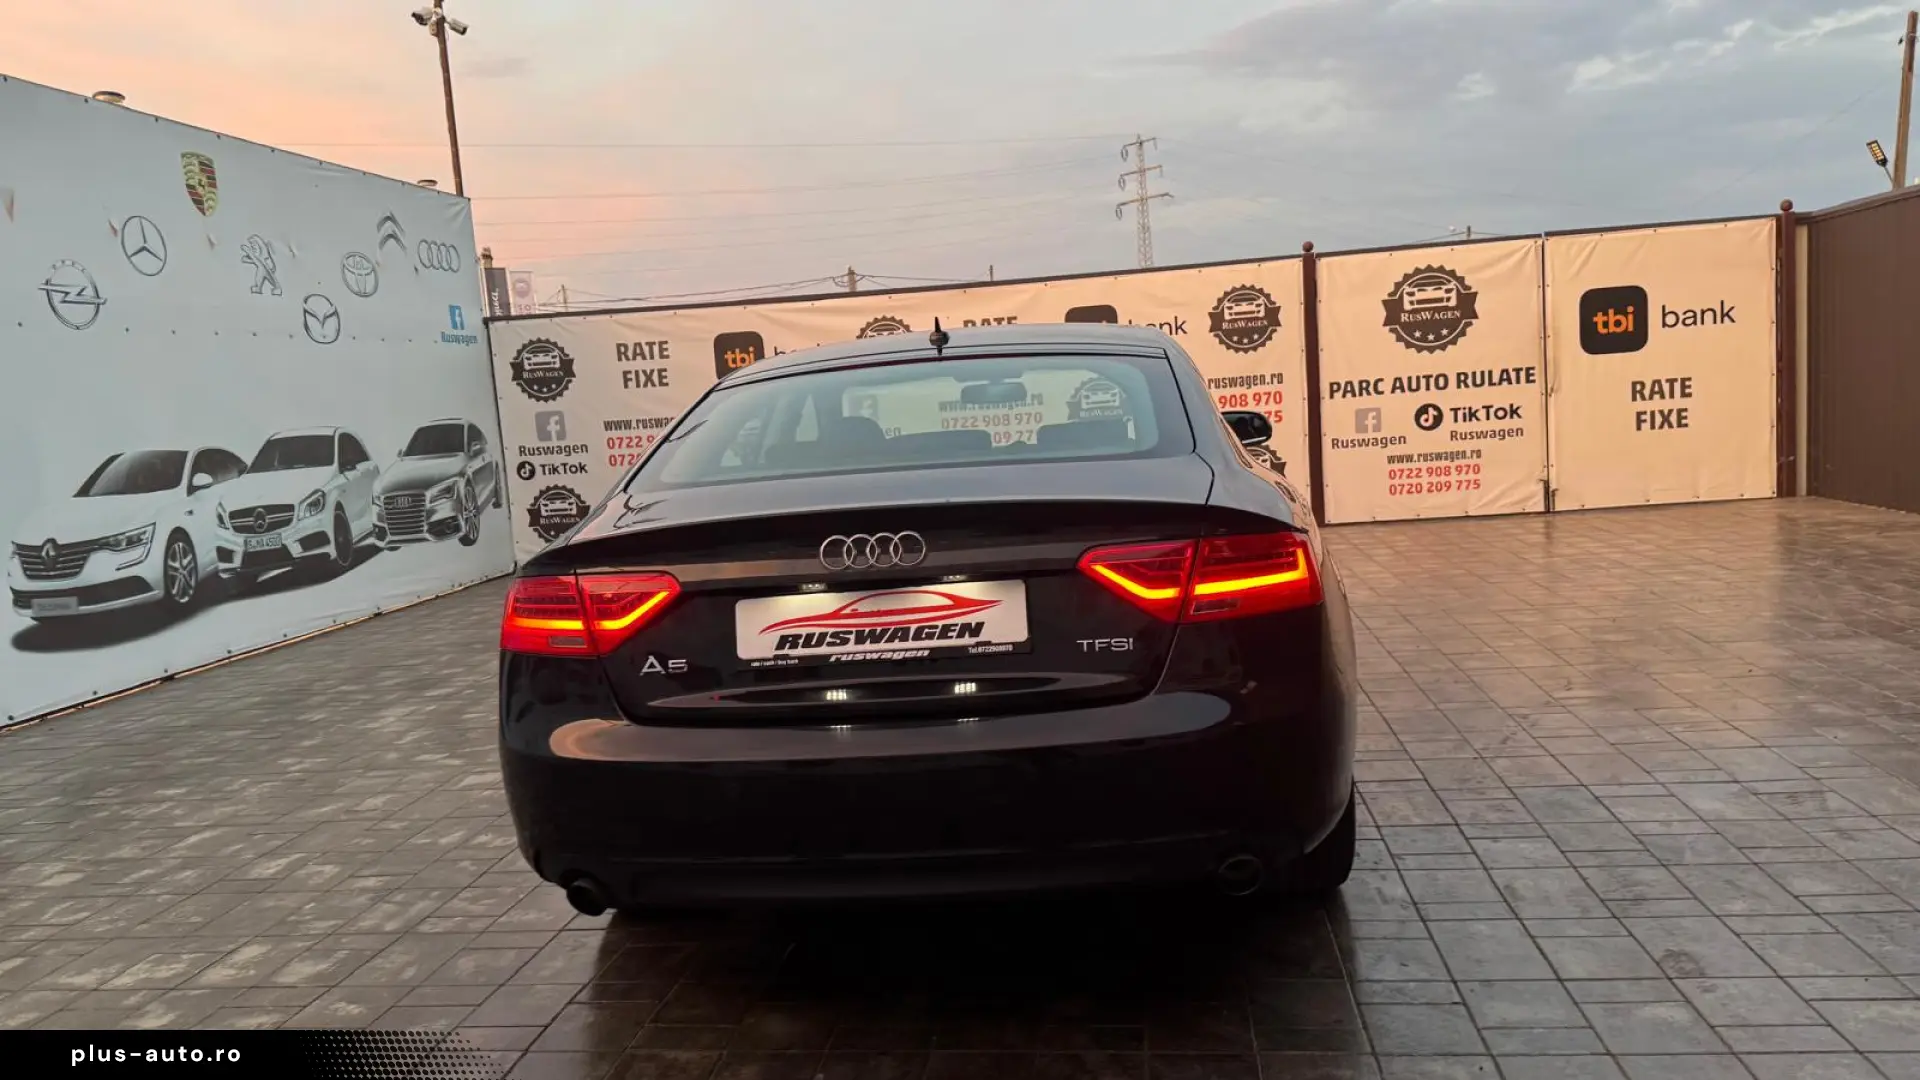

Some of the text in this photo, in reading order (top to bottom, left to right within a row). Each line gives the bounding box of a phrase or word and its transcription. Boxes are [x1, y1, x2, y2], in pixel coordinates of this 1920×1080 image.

[1593, 300, 1736, 334] tbi bank
[616, 340, 670, 362] RATE
[724, 346, 755, 368] tbi
[622, 368, 670, 389] FIXE
[1329, 366, 1537, 399] PARC AUTO RULATE
[1631, 377, 1692, 402] RATE
[1219, 391, 1283, 408] 908 970
[941, 412, 1043, 429] 0722 908 970
[1449, 403, 1522, 423] TikTok
[1636, 408, 1689, 431] FIXE
[606, 435, 643, 449] 0722
[1331, 435, 1407, 449] Ruswagen
[1450, 427, 1524, 441] Ruswagen
[518, 443, 589, 457] Ruswagen
[1387, 449, 1482, 465] www.ruswagen.ro
[539, 462, 588, 476] TikTok
[1389, 464, 1481, 480] 0722 908 970
[1389, 479, 1481, 496] 0720 209 775
[774, 621, 985, 652] RUSWAGEN
[1076, 637, 1134, 652] TFSI
[829, 648, 930, 662] ruswagen
[640, 655, 689, 676] A5
